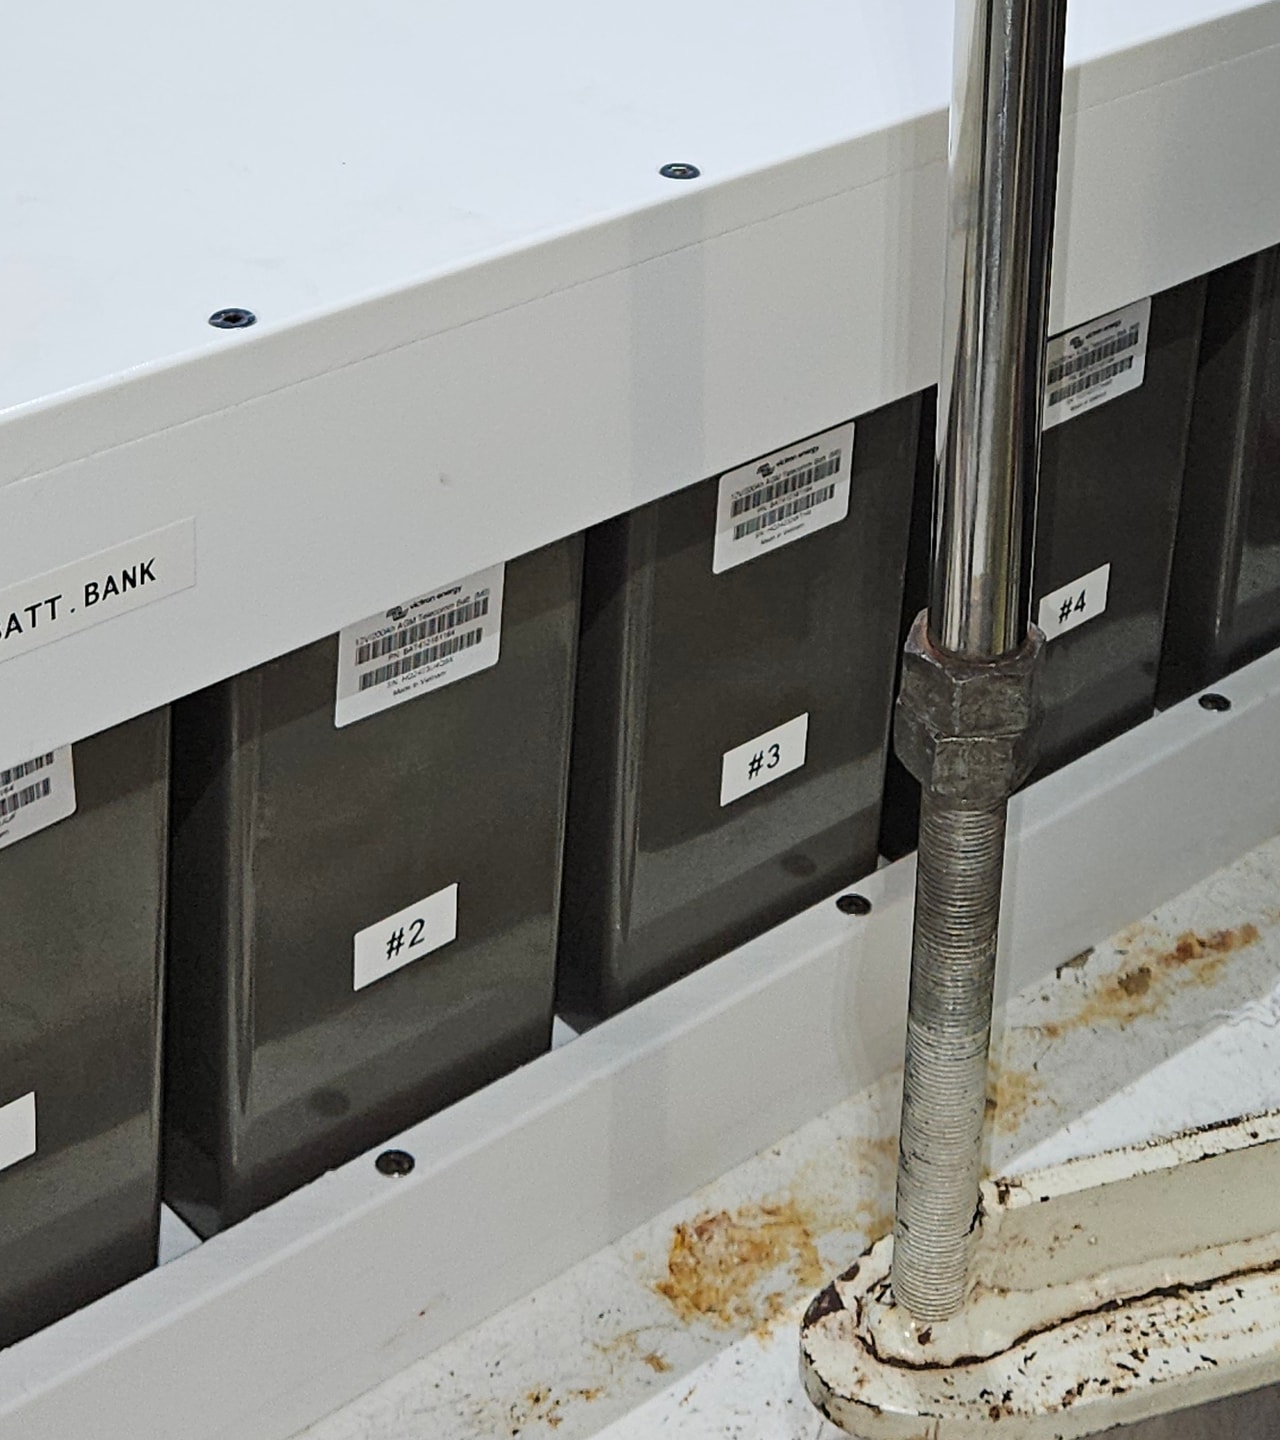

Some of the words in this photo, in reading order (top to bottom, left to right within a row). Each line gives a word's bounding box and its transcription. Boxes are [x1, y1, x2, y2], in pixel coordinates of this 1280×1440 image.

[1058, 589, 1087, 624] #4
[748, 743, 780, 781] #3
[386, 918, 426, 960] #2
